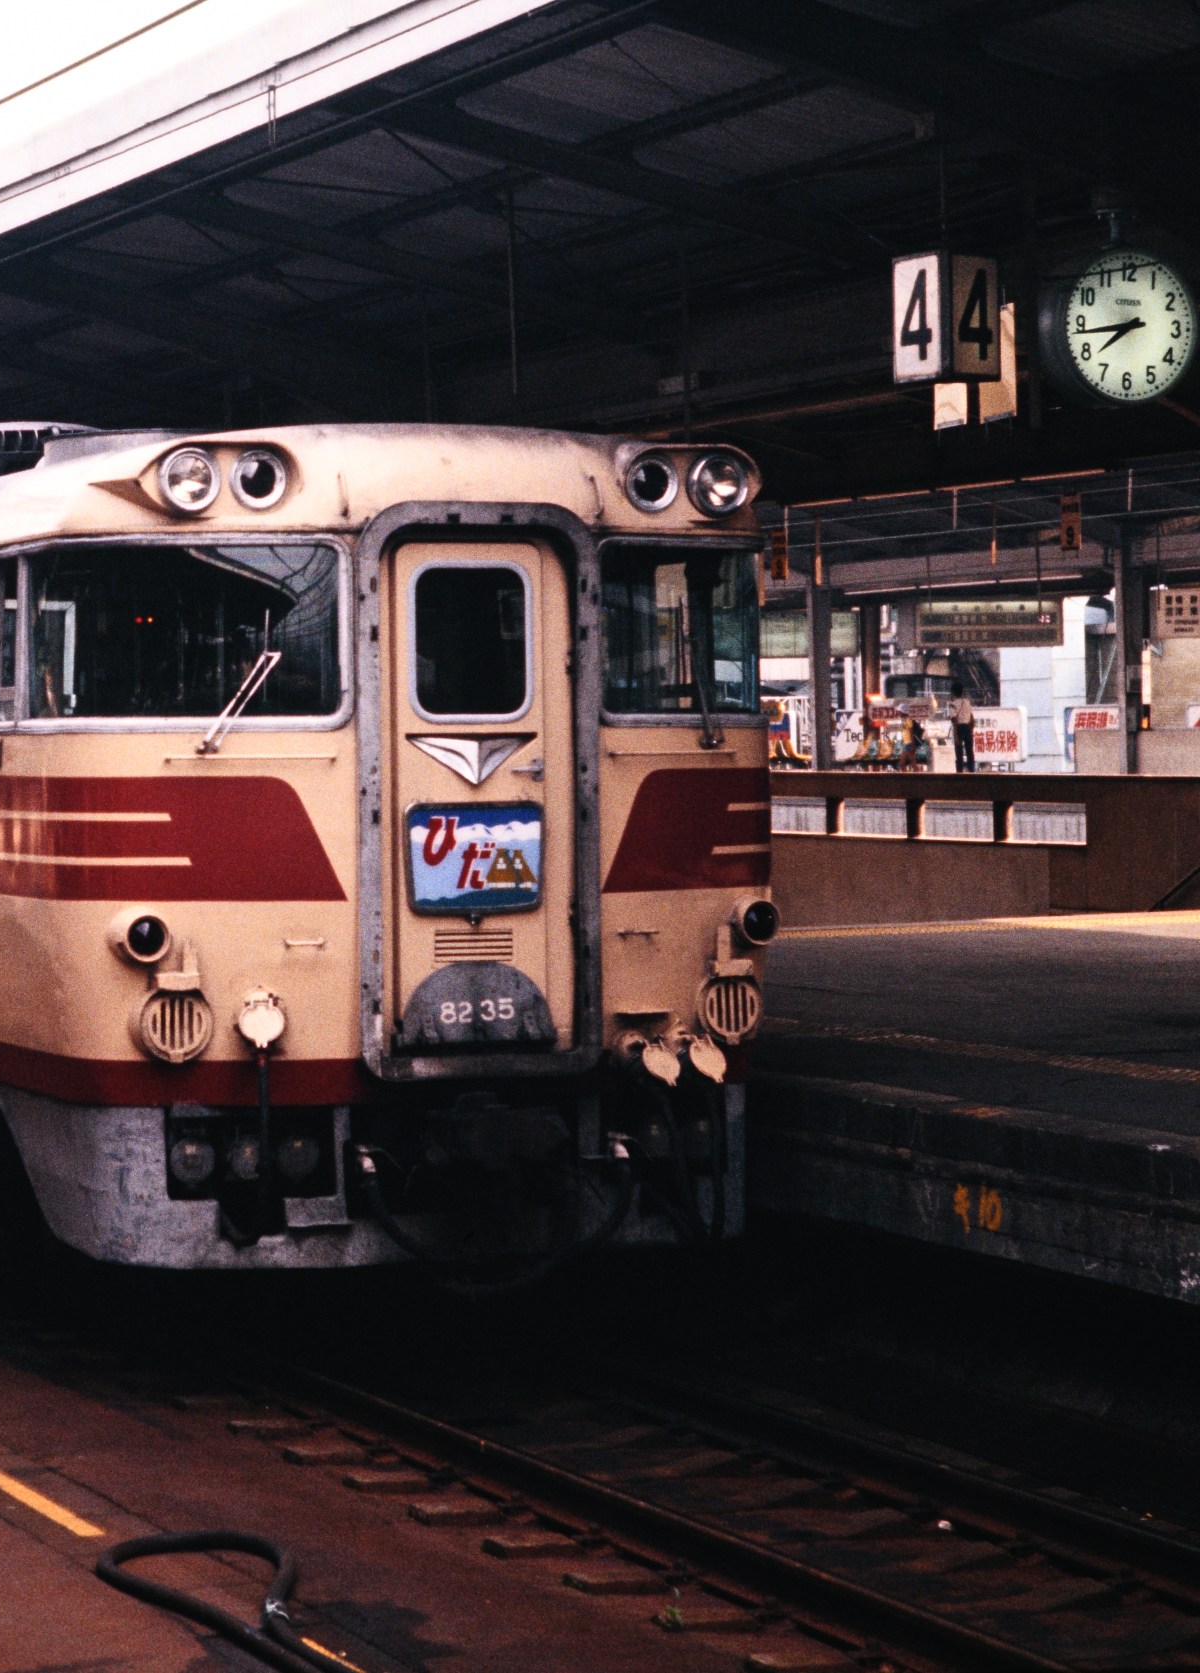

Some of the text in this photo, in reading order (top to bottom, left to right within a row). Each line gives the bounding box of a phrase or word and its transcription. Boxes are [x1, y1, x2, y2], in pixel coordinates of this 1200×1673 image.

[1100, 269, 1112, 288] 11
[1122, 263, 1136, 282] 12
[1151, 271, 1156, 290] 1
[1081, 287, 1095, 306] 10
[1115, 298, 1142, 306] CITIZEN
[1165, 292, 1175, 311] 2
[901, 268, 932, 361] 4
[959, 268, 993, 361] 4
[1076, 314, 1086, 333] 9
[1171, 320, 1181, 339] 3
[1081, 342, 1092, 361] 8
[1163, 347, 1174, 366] 4
[1099, 363, 1109, 382] 7
[1122, 372, 1132, 391] 6
[1146, 366, 1156, 385] 5
[423, 816, 496, 889] ひだ
[440, 998, 515, 1024] 82 35
